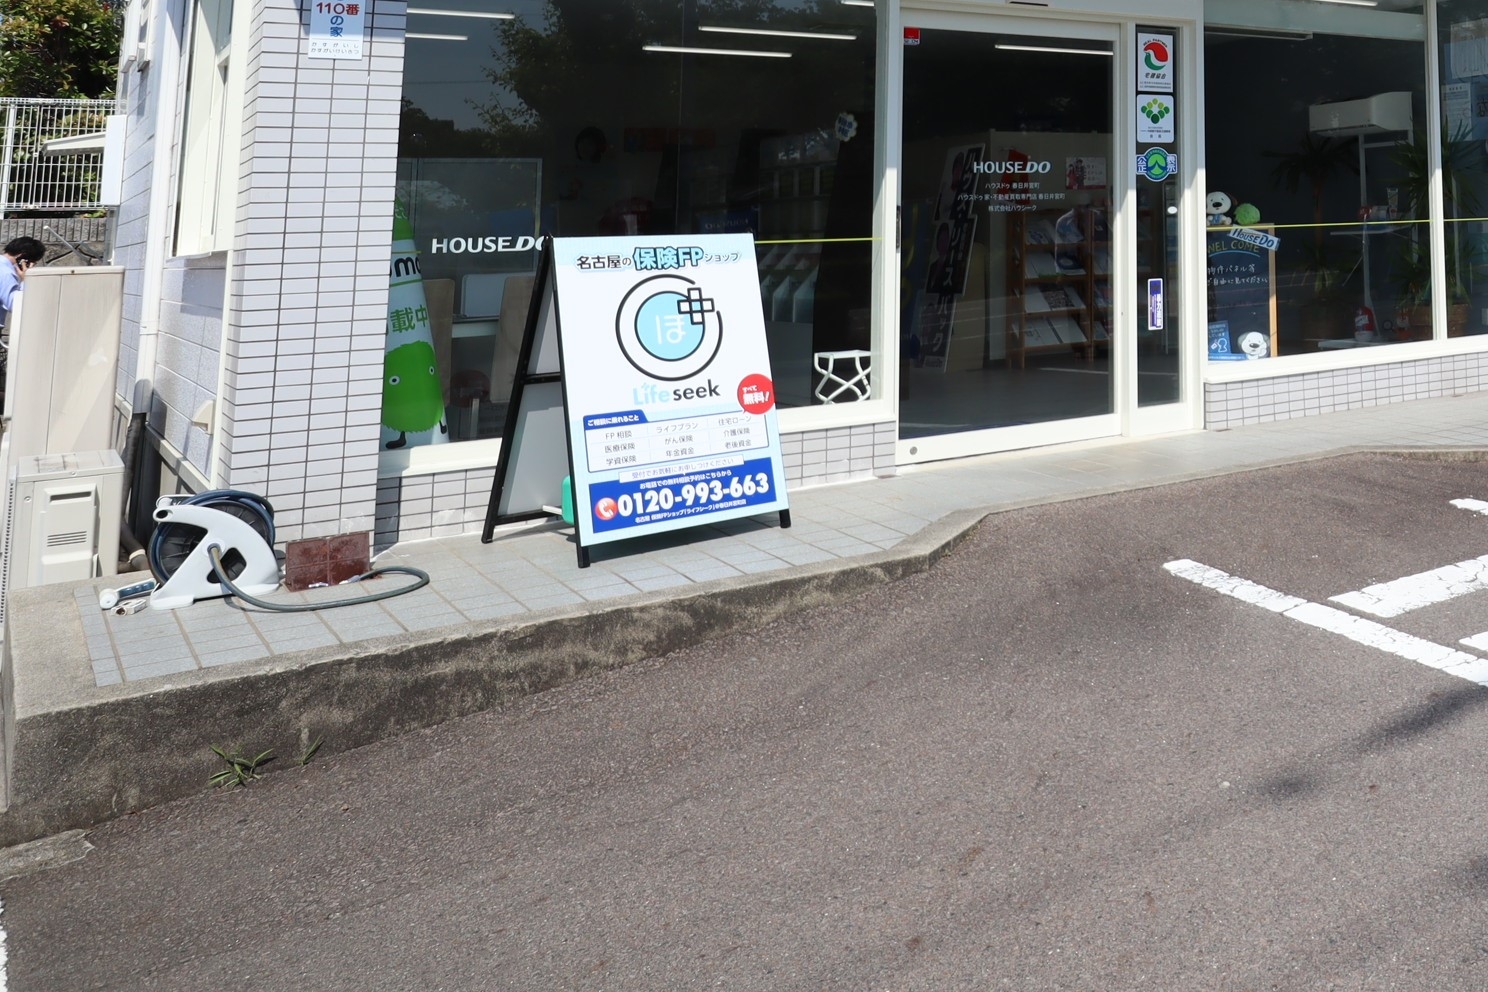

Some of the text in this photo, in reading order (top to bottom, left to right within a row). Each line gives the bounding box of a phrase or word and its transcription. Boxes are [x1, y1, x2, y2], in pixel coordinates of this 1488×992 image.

[316, 2, 360, 16] 110番
[330, 15, 344, 37] の家
[655, 314, 687, 345] ほ
[617, 472, 770, 517] 0120-993-663
